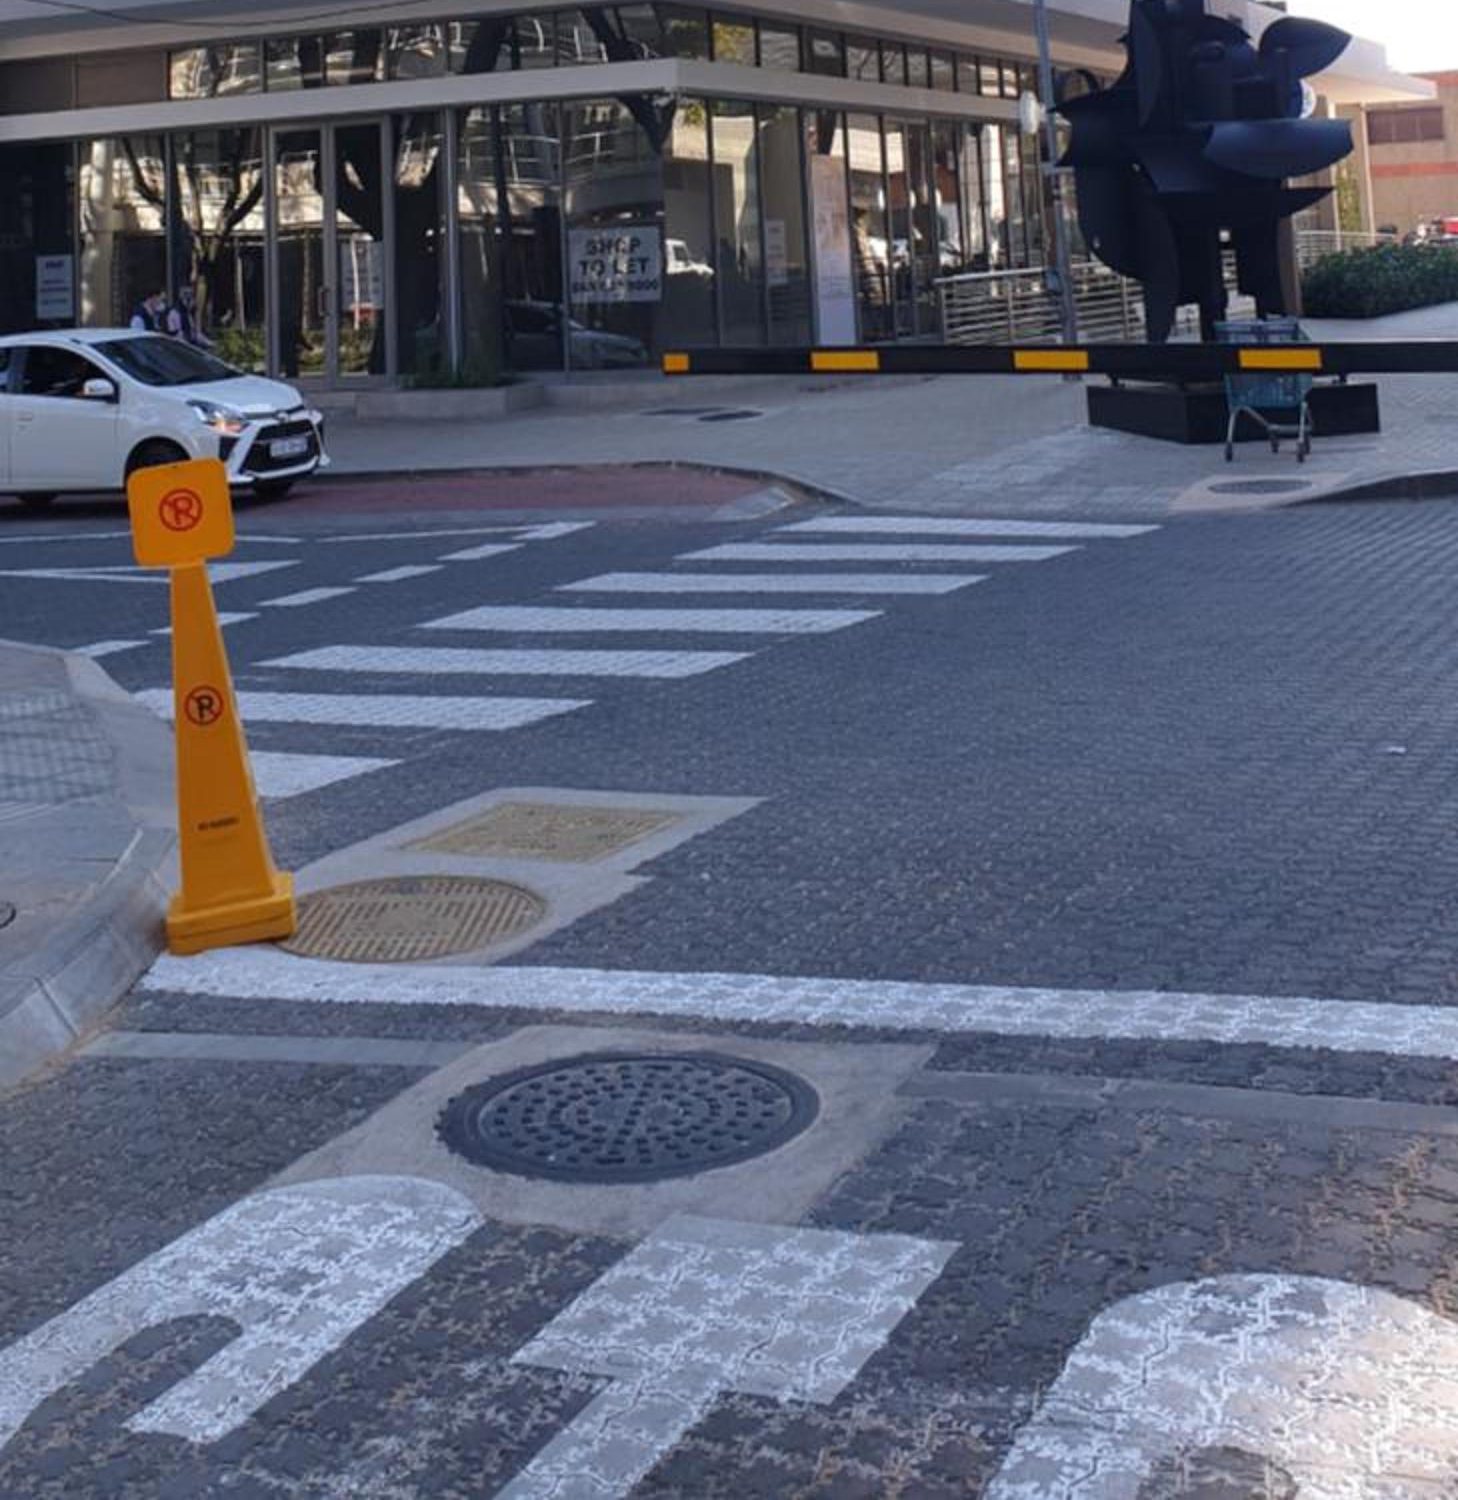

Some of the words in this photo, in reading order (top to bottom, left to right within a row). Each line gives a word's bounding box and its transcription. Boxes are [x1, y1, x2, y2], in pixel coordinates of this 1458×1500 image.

[585, 237, 641, 255] SHOP
[578, 260, 605, 277] TO
[613, 257, 650, 275] LET
